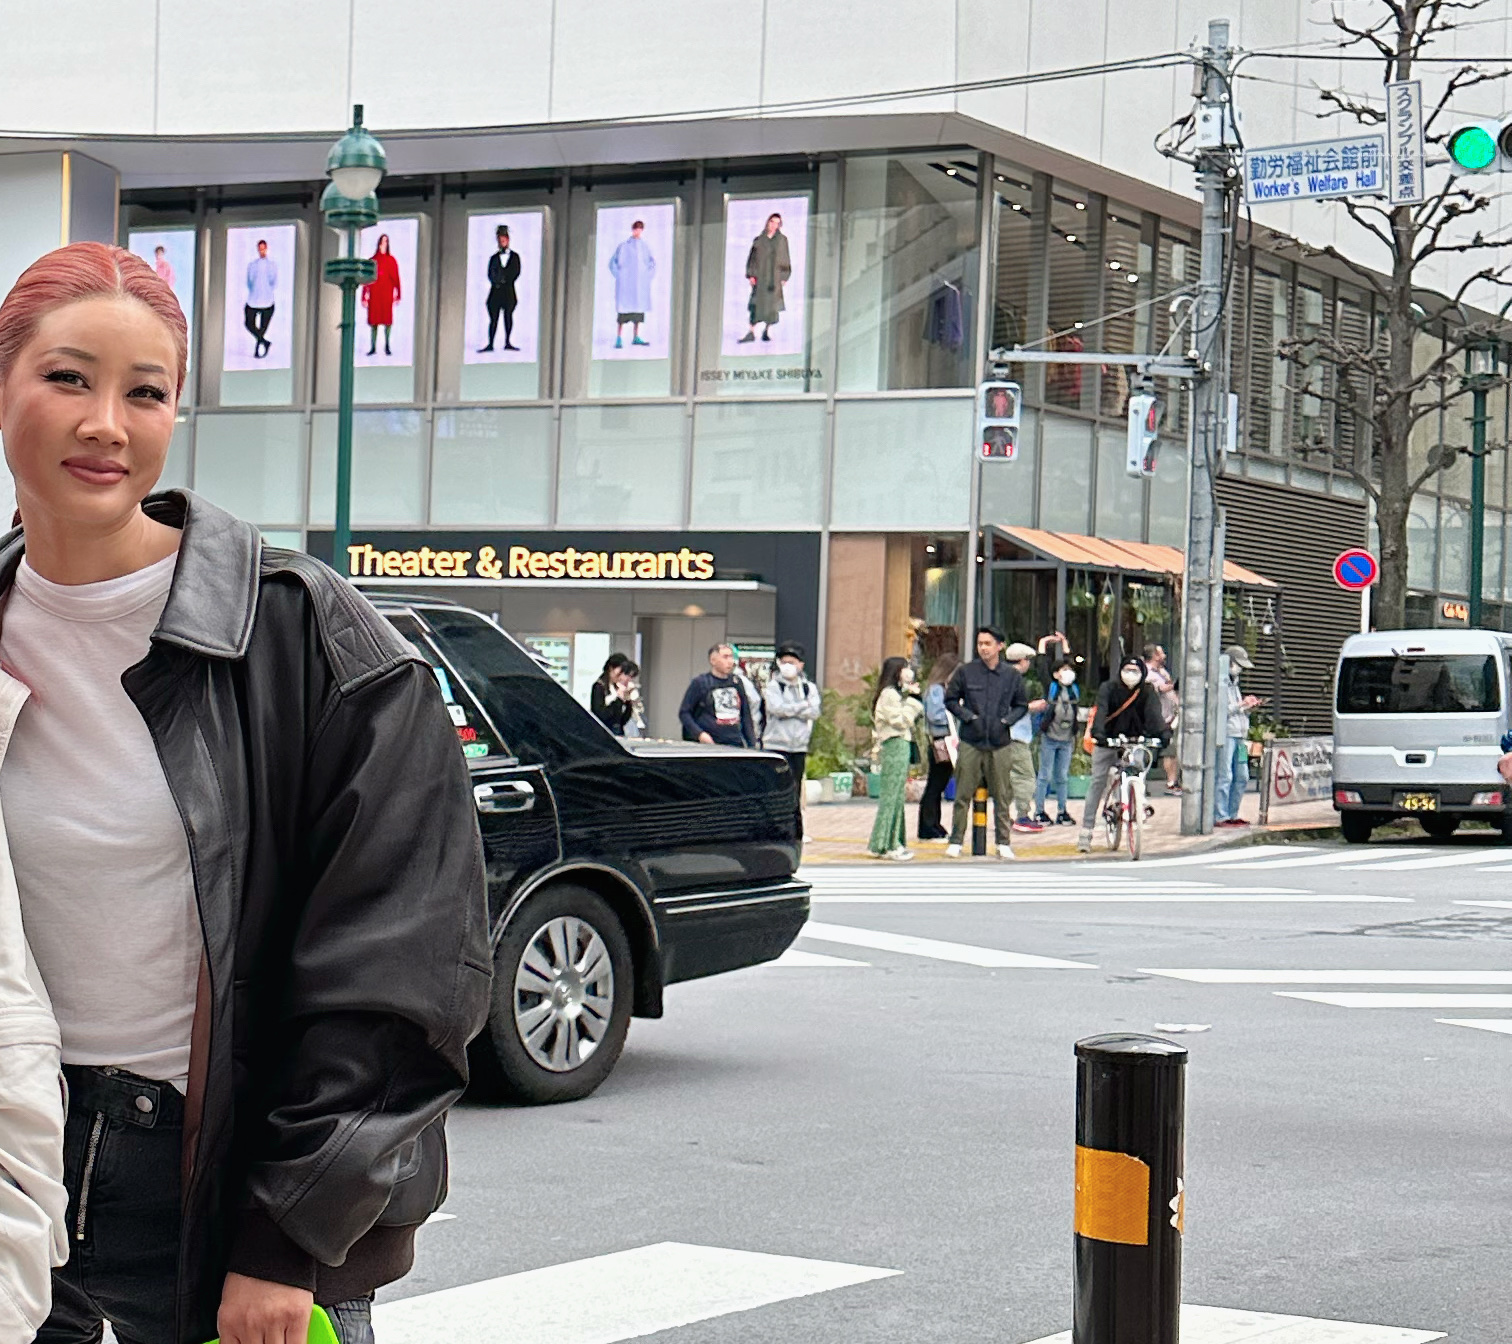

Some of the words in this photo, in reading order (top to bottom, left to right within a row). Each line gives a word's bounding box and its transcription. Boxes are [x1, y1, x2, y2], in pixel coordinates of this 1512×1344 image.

[1250, 143, 1379, 181] 勤労福祉会館前
[1253, 179, 1300, 199] Worker's
[1307, 174, 1348, 193] Welfare
[1356, 169, 1377, 188] Hall
[347, 544, 472, 577] Theater
[475, 545, 502, 579] &
[508, 545, 714, 580] Restaurants
